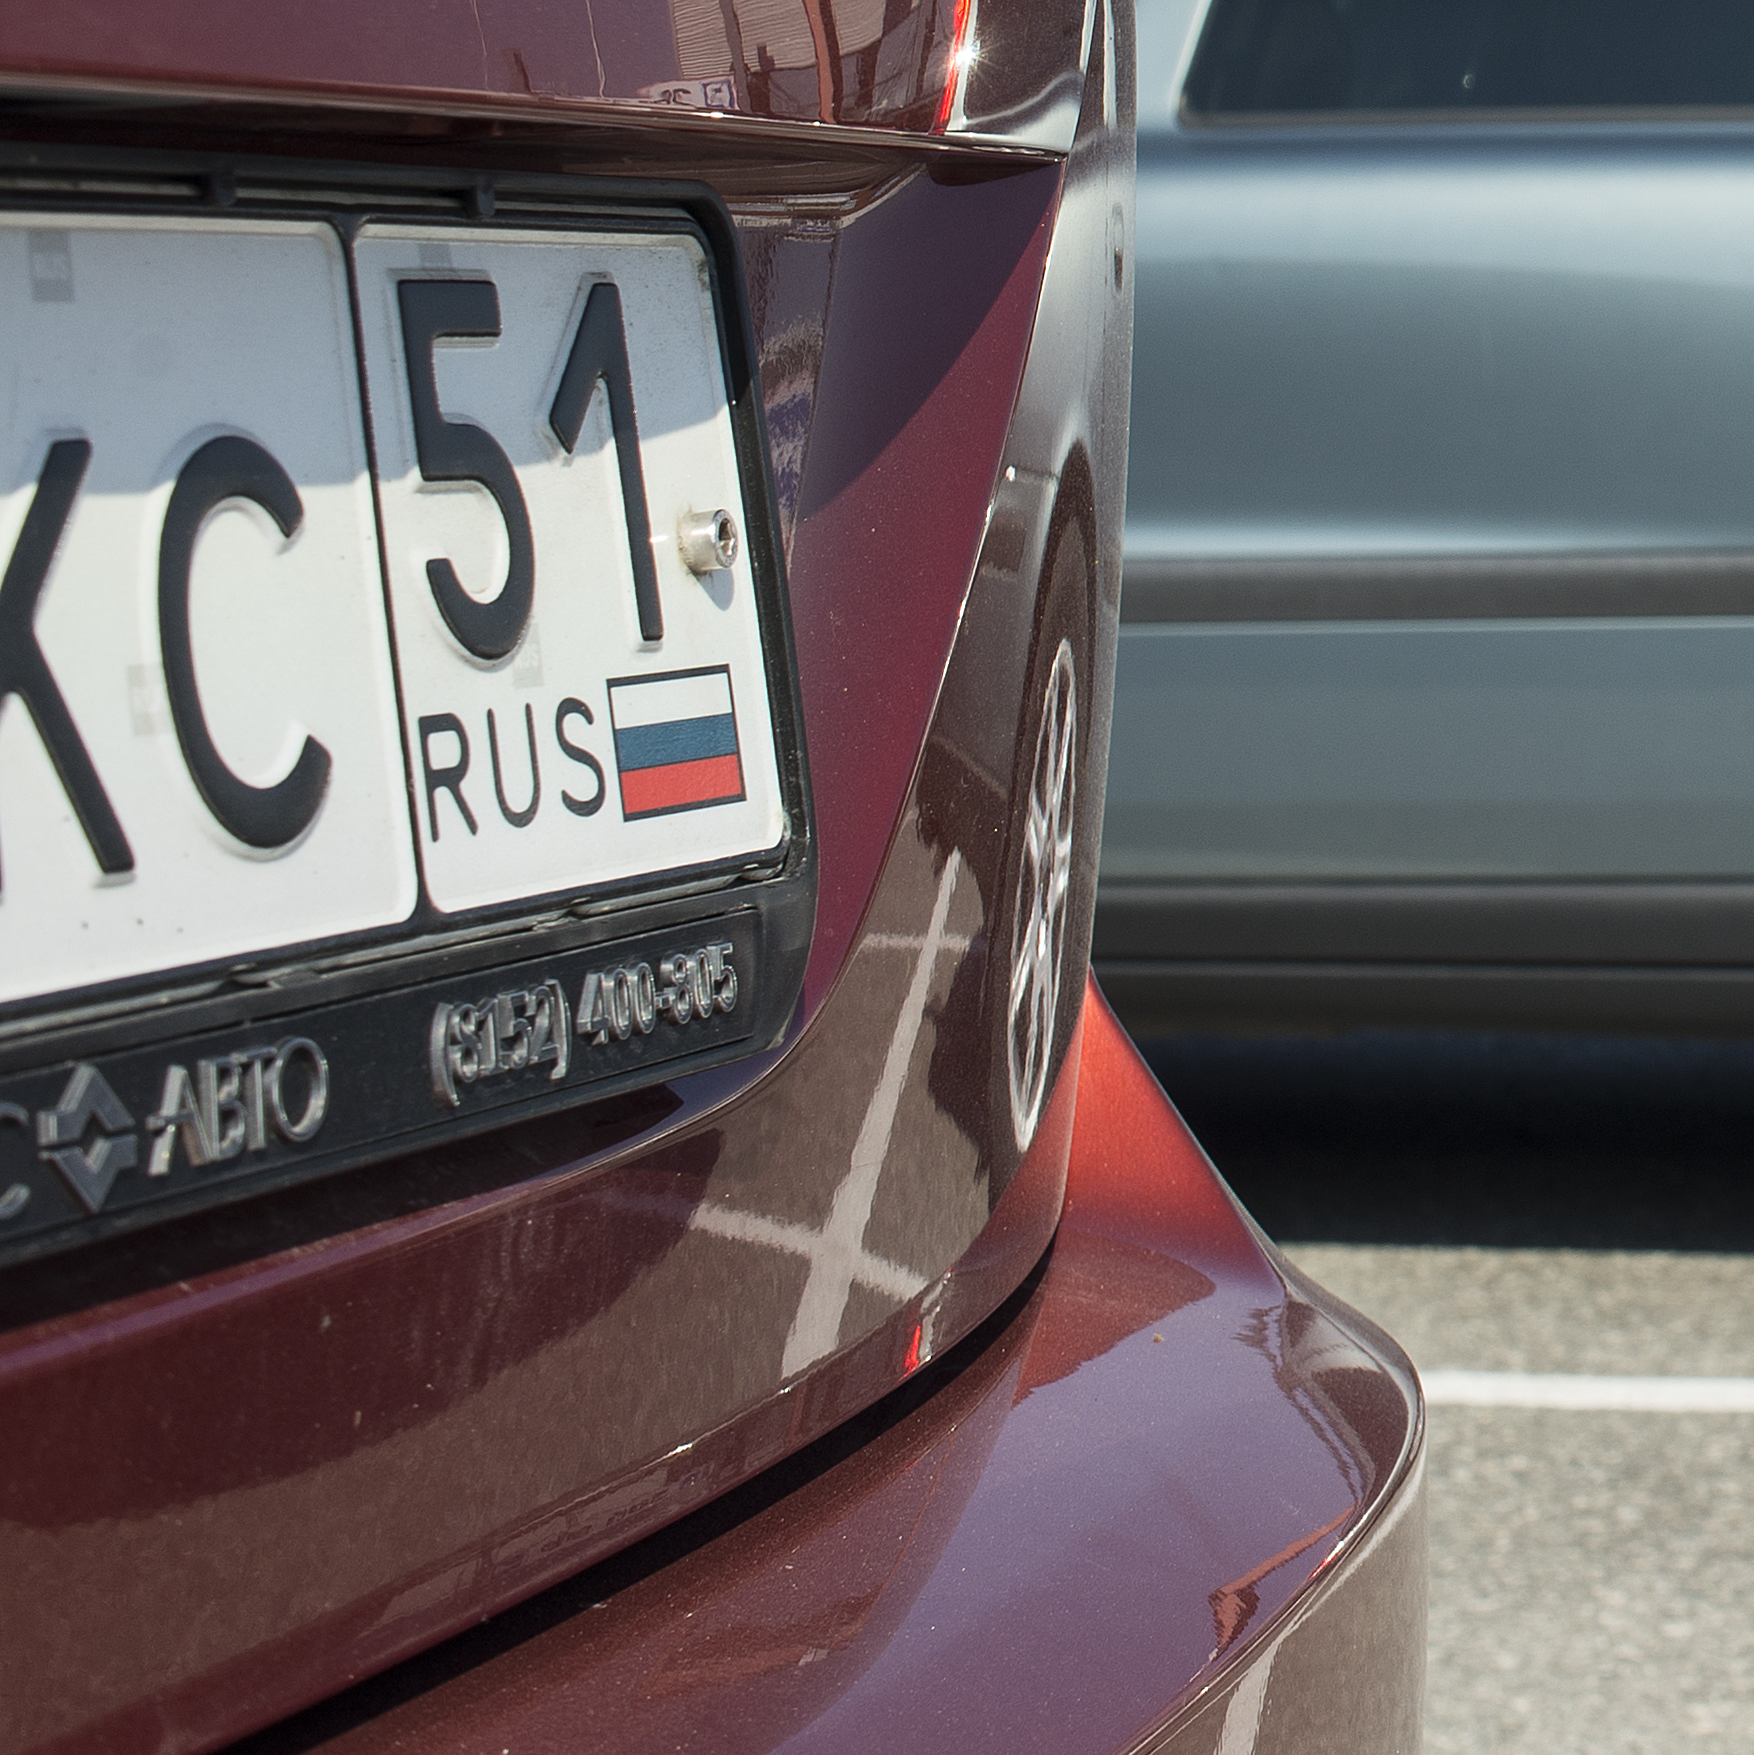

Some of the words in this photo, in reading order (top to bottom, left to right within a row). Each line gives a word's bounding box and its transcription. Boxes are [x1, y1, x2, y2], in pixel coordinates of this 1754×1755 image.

[397, 279, 664, 661] 51
[418, 697, 607, 843] RUS
[430, 978, 572, 1108] (8152)
[576, 942, 738, 1046] 400-805
